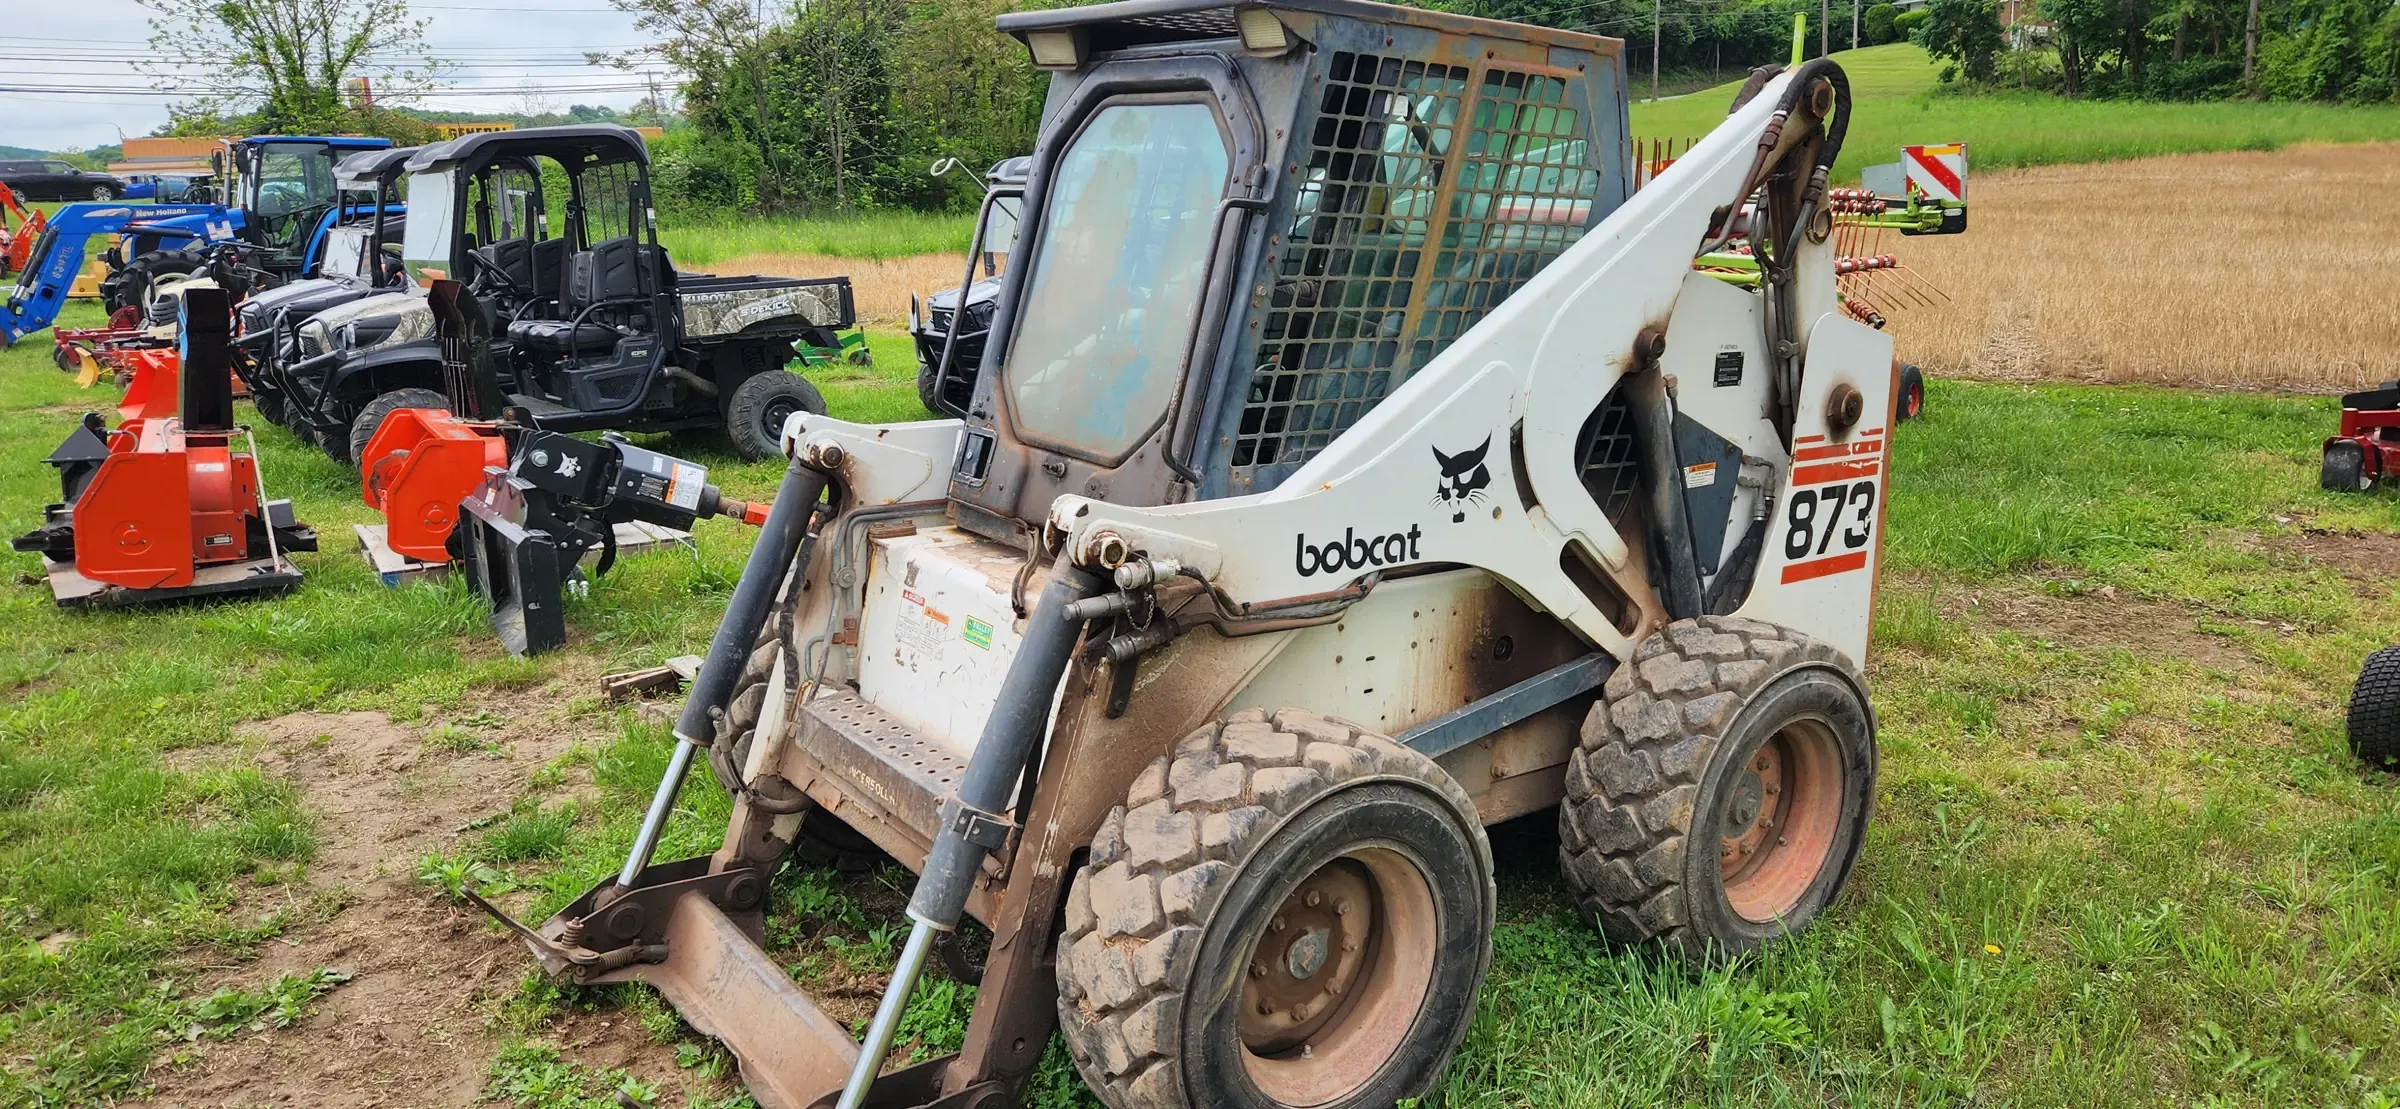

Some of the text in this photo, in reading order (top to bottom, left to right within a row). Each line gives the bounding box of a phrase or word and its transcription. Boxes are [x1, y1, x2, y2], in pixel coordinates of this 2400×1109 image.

[156, 208, 187, 216] Holland
[682, 293, 733, 304] KUBOTA
[740, 299, 791, 317] SDEKICK
[1785, 481, 1875, 560] 873
[1296, 523, 1421, 577] bobcat
